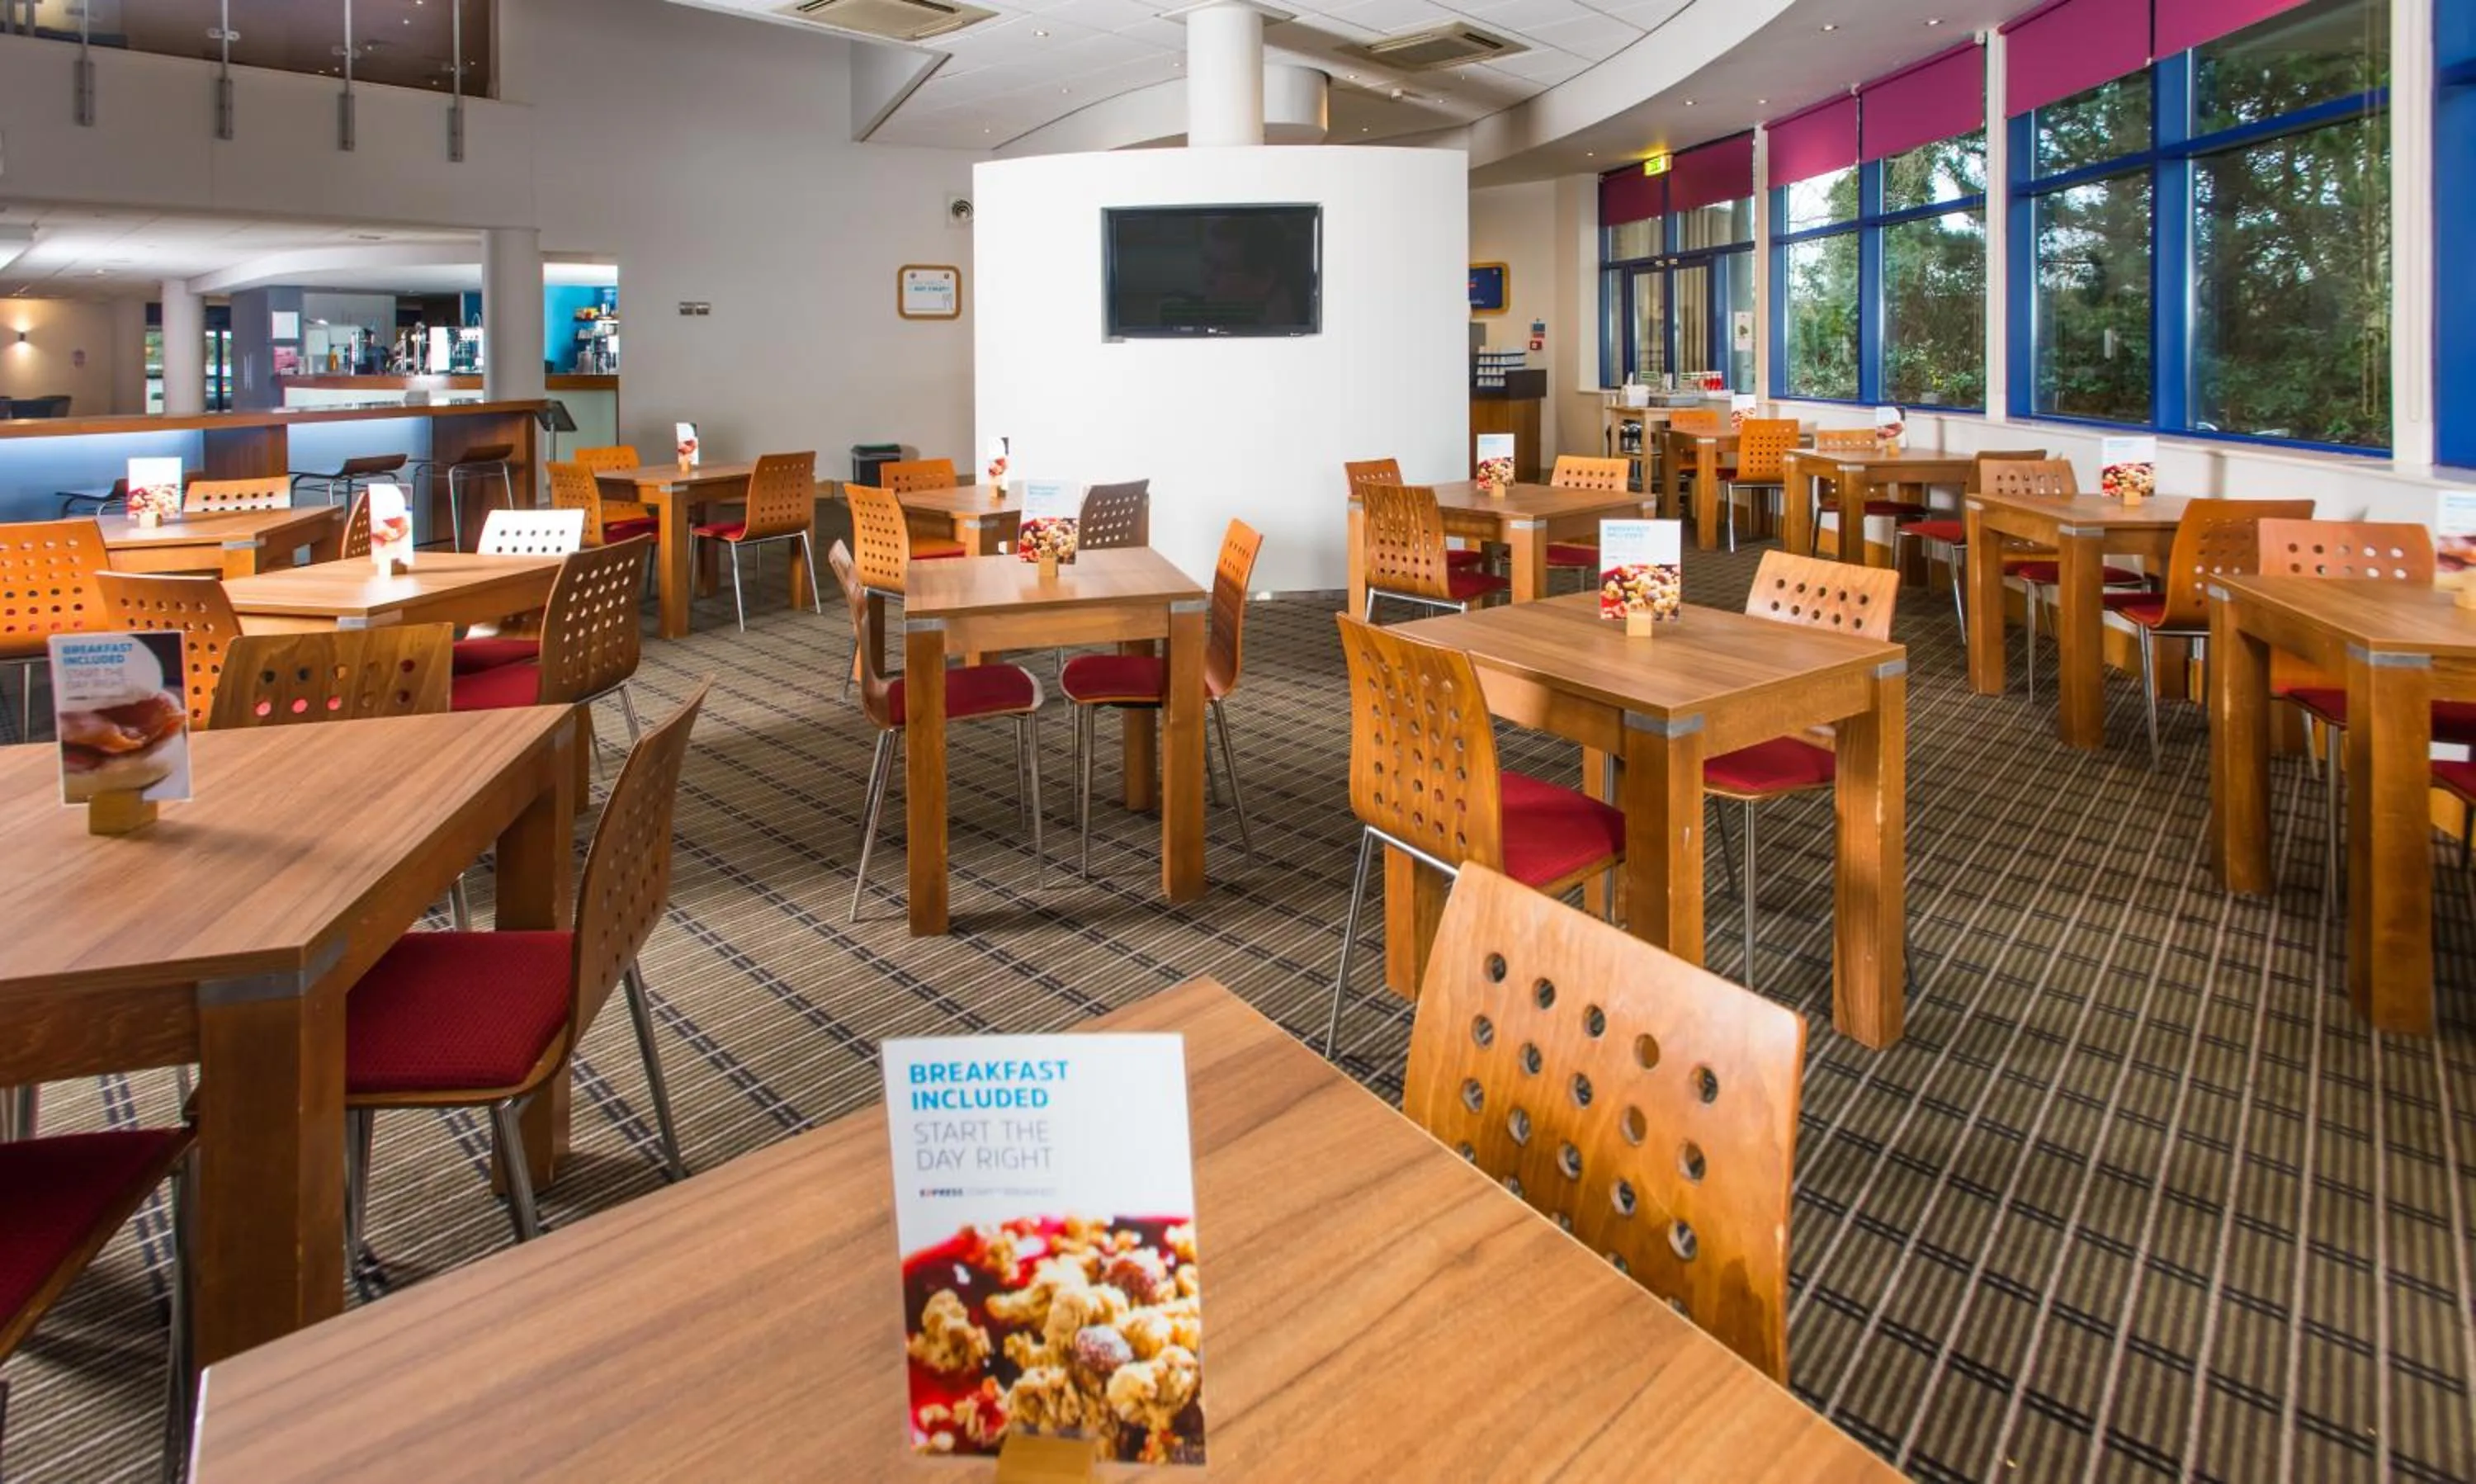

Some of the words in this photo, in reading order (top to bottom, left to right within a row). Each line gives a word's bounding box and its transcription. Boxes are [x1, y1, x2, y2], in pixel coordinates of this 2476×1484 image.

[910, 1060, 1069, 1085] BREAKFAST
[911, 1087, 1049, 1111] INCLUDED
[913, 1119, 990, 1145] START
[1001, 1118, 1050, 1143] THE
[915, 1148, 966, 1171] DAY
[976, 1146, 1053, 1170] RIGHT
